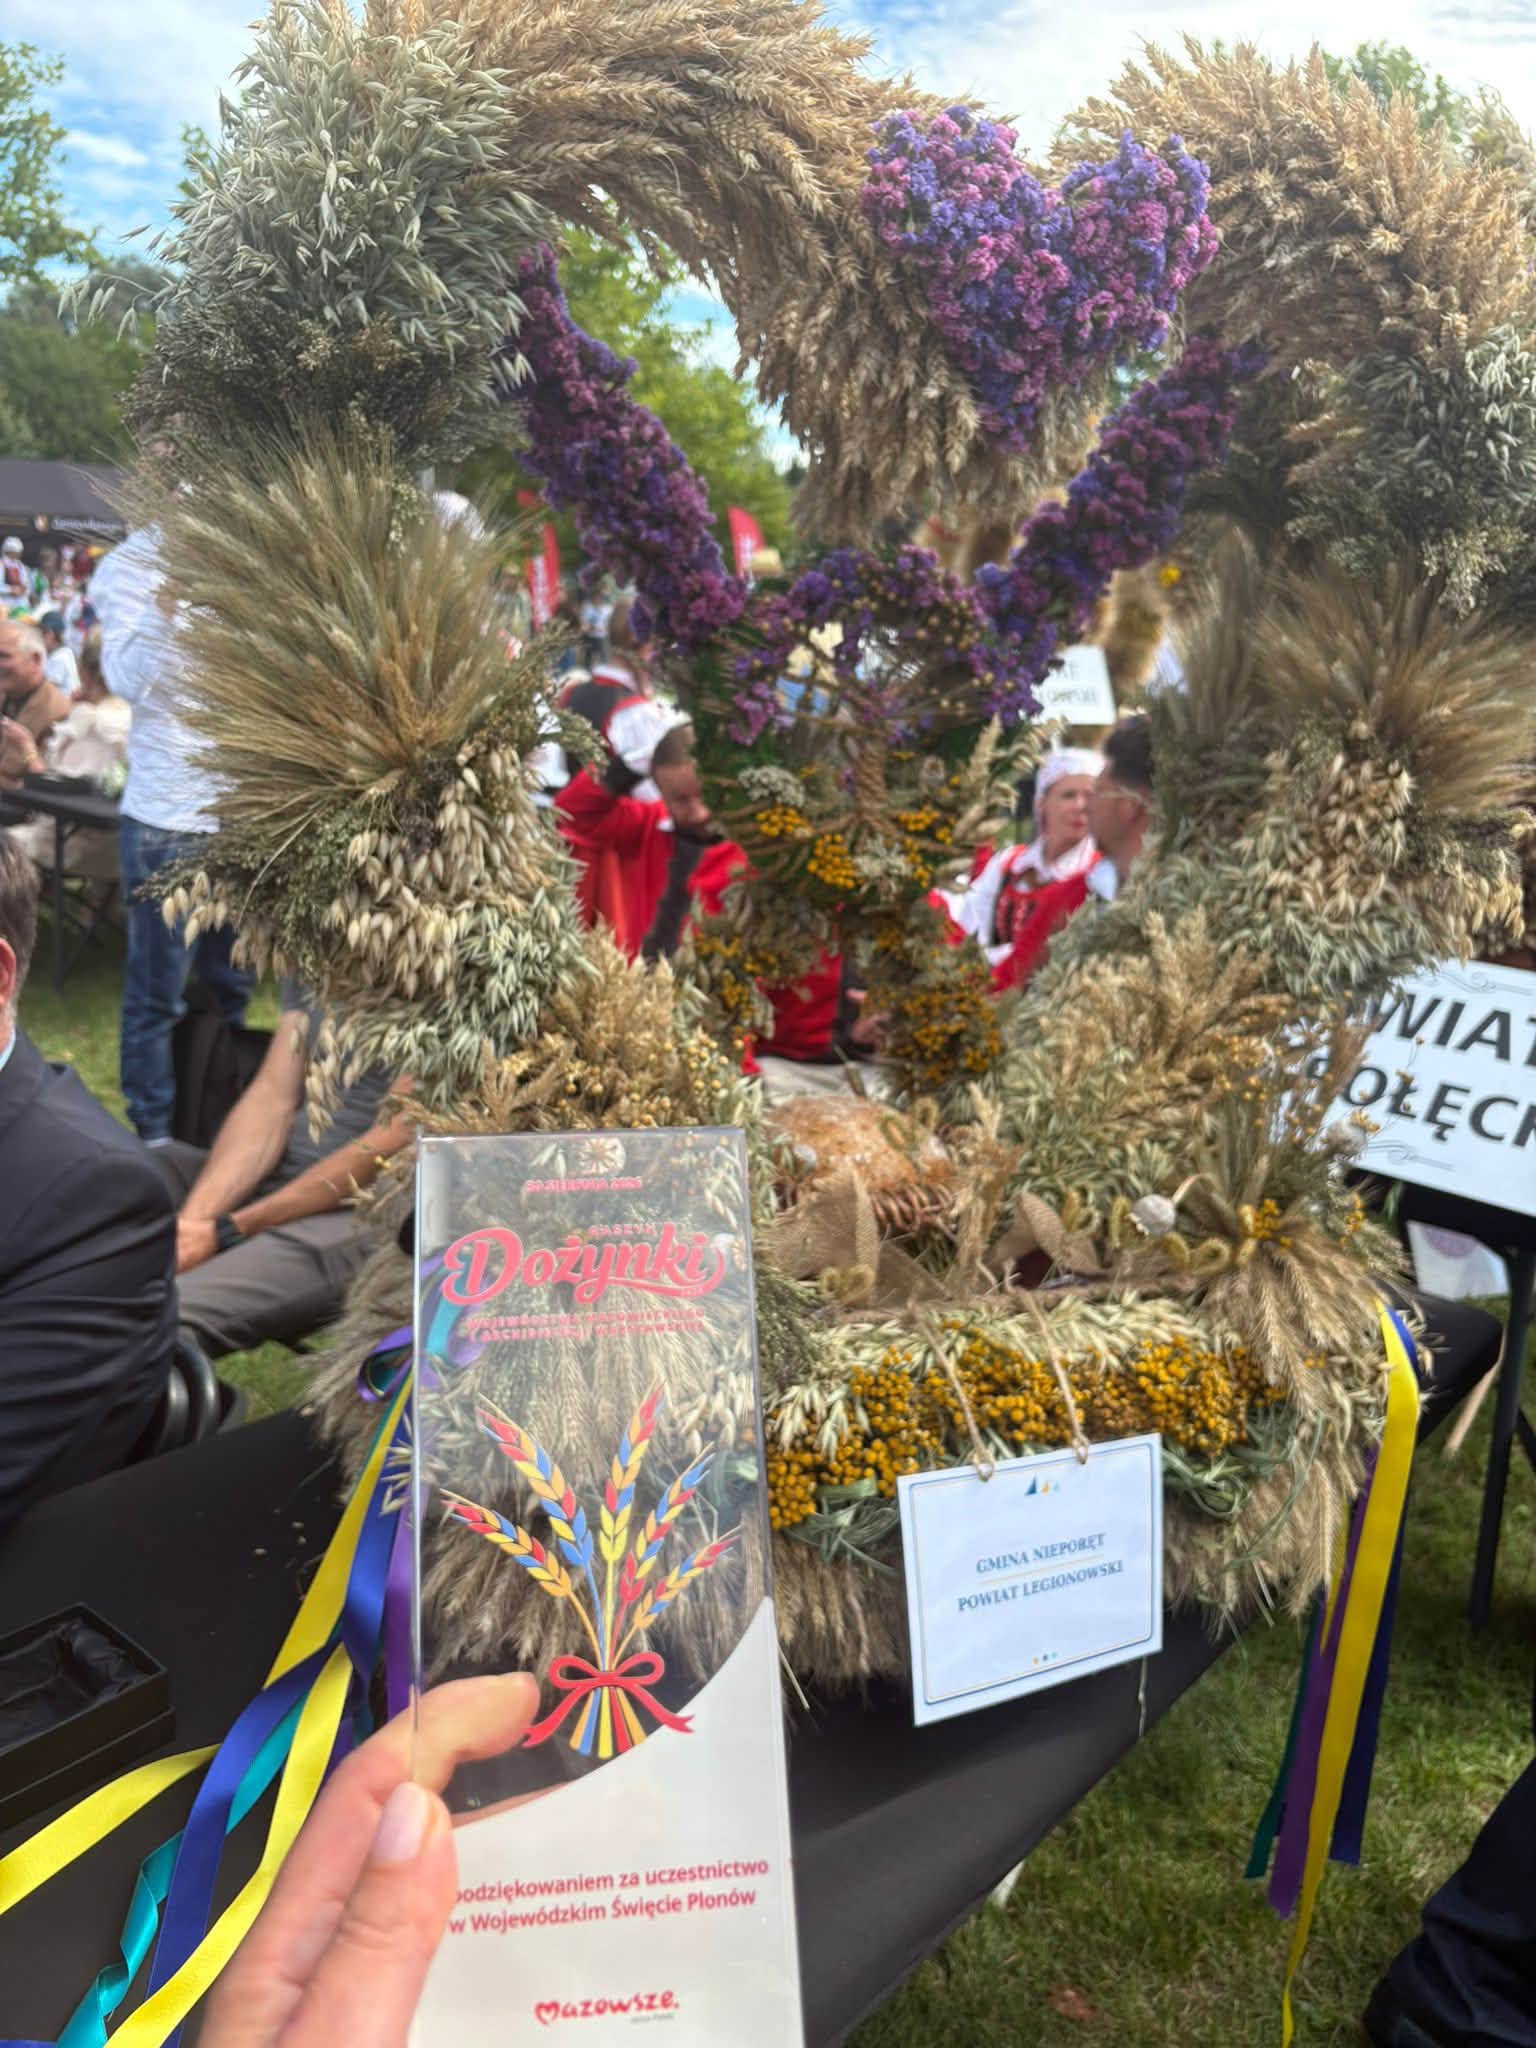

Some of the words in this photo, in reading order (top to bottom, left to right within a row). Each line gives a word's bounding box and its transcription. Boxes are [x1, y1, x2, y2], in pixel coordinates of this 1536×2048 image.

[441, 1222, 726, 1304] Dożynki
[976, 1549, 1030, 1574] GMINA
[1033, 1533, 1105, 1561] NIEPORĘT
[957, 1585, 1018, 1611] POWIAT
[1023, 1560, 1123, 1596] LEGIONOWSKI
[619, 1871, 640, 1889] za
[645, 1859, 768, 1886] uczestnictwo
[449, 1918, 465, 1933] w
[470, 1901, 607, 1936] Wojewódzkim
[611, 1892, 682, 1919] Święcie
[686, 1886, 756, 1912] Plonów
